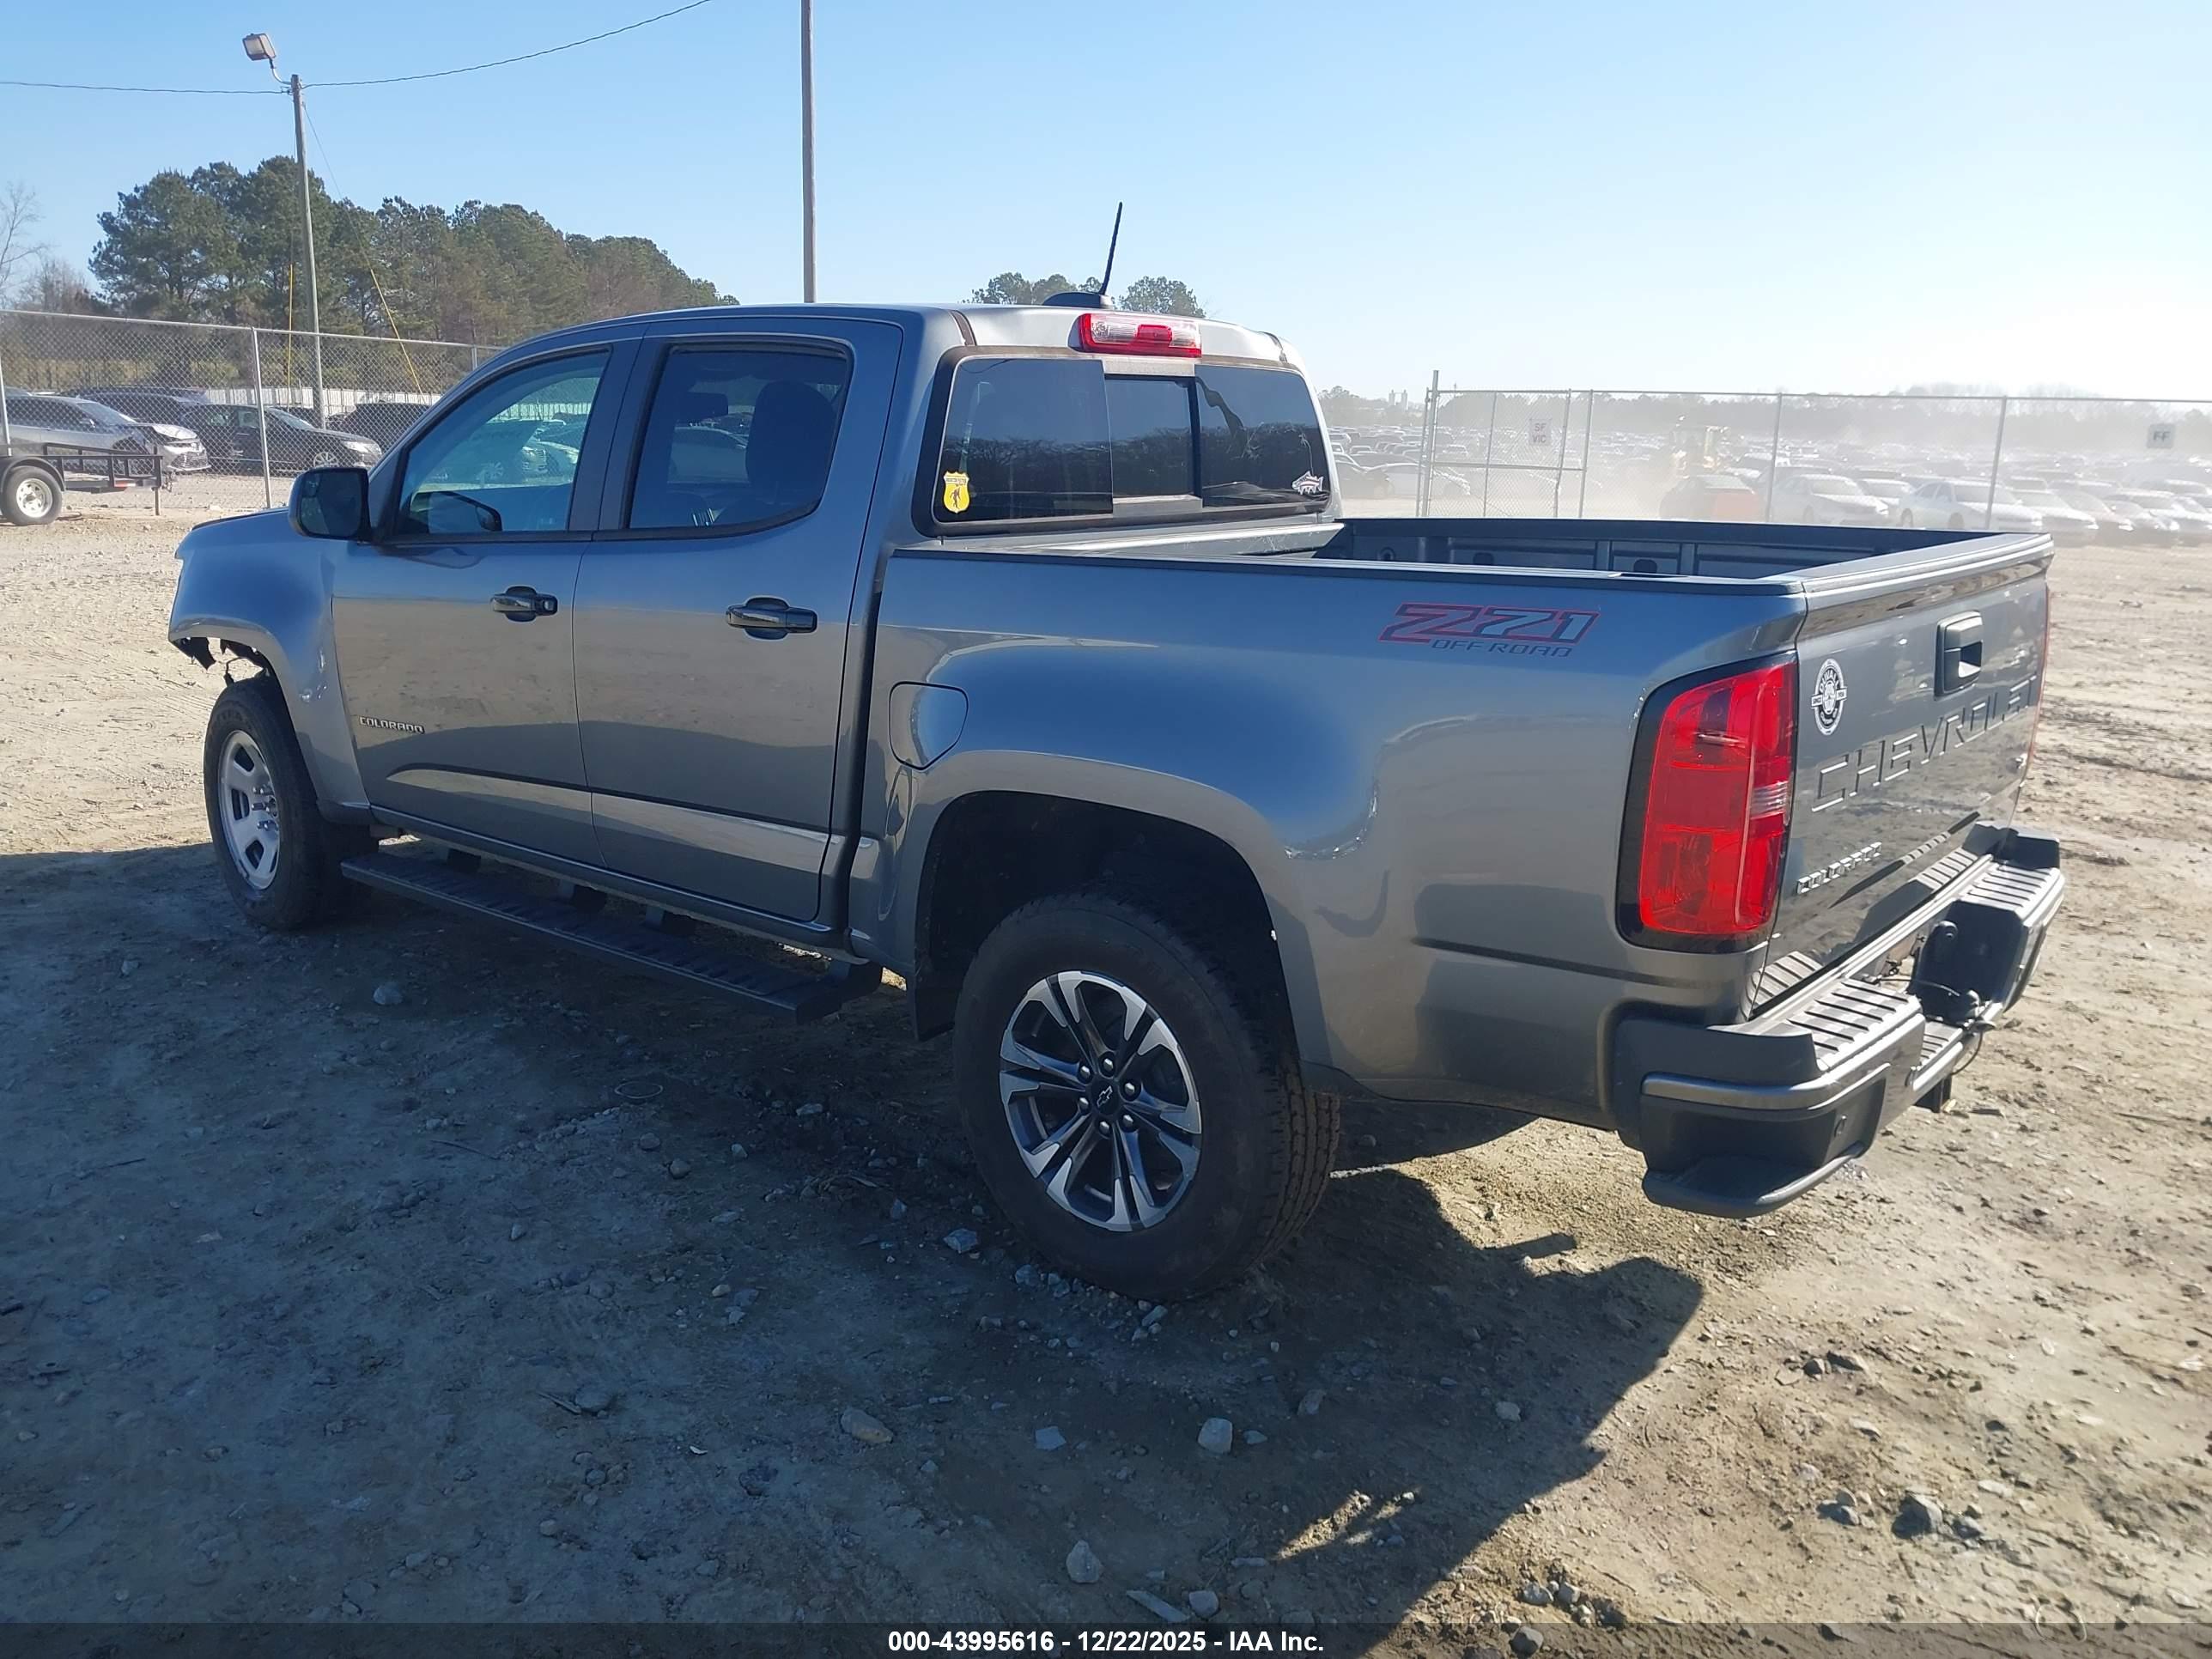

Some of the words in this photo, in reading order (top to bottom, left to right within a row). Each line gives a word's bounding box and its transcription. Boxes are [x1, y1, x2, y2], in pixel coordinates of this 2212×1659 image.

[1377, 602, 1601, 644] Z71
[1431, 638, 1485, 653] OFF
[1488, 642, 1572, 658] ROAD
[359, 715, 426, 734] COLORADO
[1812, 673, 2039, 811] CHEVROLET
